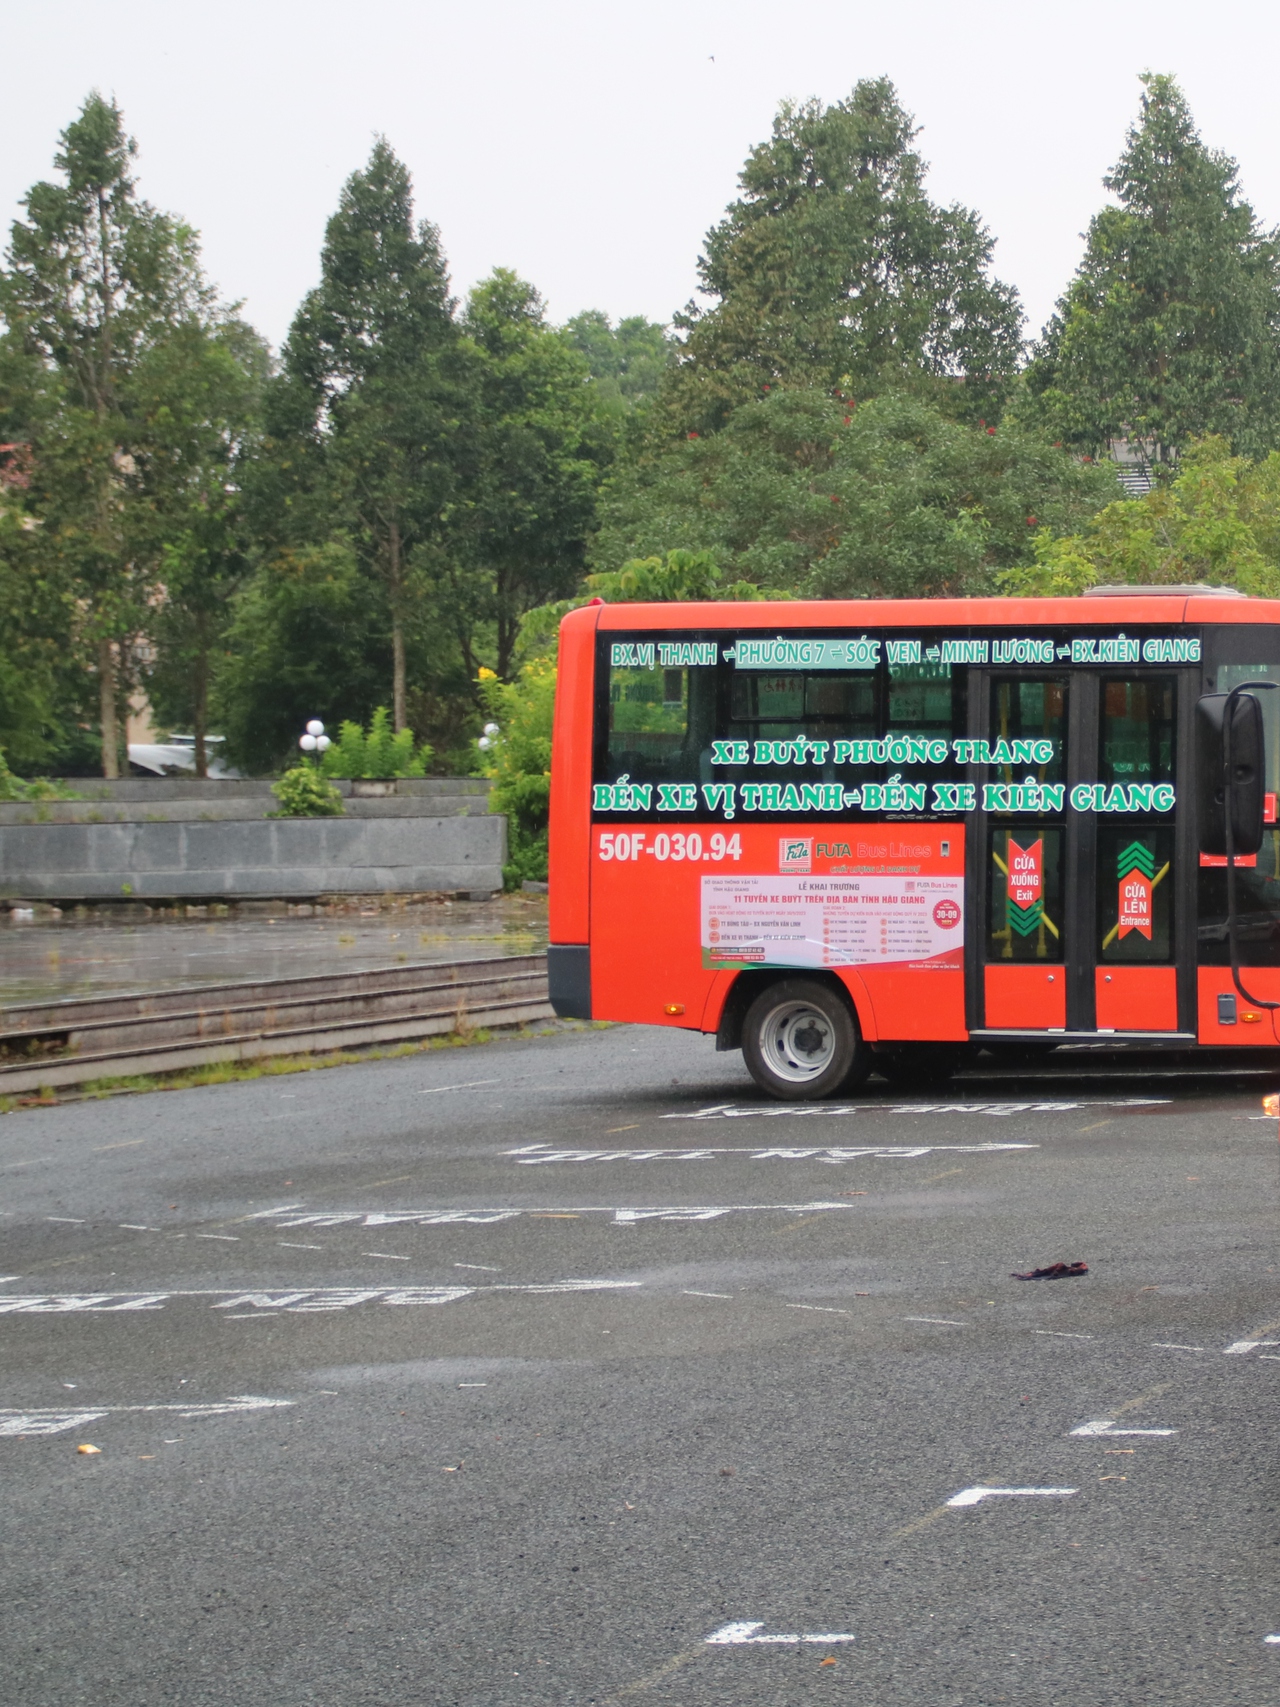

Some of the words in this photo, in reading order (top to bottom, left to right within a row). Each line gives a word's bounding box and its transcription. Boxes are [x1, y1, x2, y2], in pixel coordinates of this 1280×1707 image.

[611, 643, 655, 670] BX.VỊ
[660, 643, 717, 665] THANH
[738, 636, 811, 664] PHƯỜNG
[814, 643, 825, 663] 7
[845, 636, 880, 664] SÓC
[886, 641, 921, 664] VEN
[941, 640, 987, 664] MINH
[993, 639, 1054, 664] LƯƠNG
[1071, 633, 1140, 663] BX.KIÊN
[1143, 639, 1200, 663] GIANG
[711, 740, 749, 764] XE
[753, 735, 828, 765] BUÝT
[834, 735, 947, 765] PHƯƠNG
[952, 739, 1054, 764] TRANG
[593, 774, 652, 812] BẾN
[657, 784, 697, 811] XE
[701, 785, 736, 819] VỊ
[740, 784, 844, 812] THANH
[861, 774, 926, 812] BẾN
[931, 783, 976, 811] XE
[982, 776, 1066, 812] KIÊN
[1071, 783, 1176, 812] GIANG
[599, 833, 742, 861] 50F-030.94
[857, 843, 888, 857] Bus
[890, 843, 931, 857] Lines
[1014, 853, 1035, 870] CỬA
[810, 883, 828, 891] KHAI
[829, 882, 860, 891] TRƯƠNG
[1010, 872, 1039, 887] XUỐNG
[1016, 889, 1033, 901] Exit
[1125, 881, 1146, 899] CỬA
[734, 895, 742, 903] 11
[744, 893, 768, 903] TUYẾN
[770, 895, 780, 903] XE
[782, 894, 802, 903] BUÝT
[804, 894, 824, 903] TRÊN
[900, 896, 925, 904] GIANG
[1123, 897, 1148, 914] LÊN
[936, 910, 958, 918] 30-09
[1120, 915, 1150, 926] Entrance
